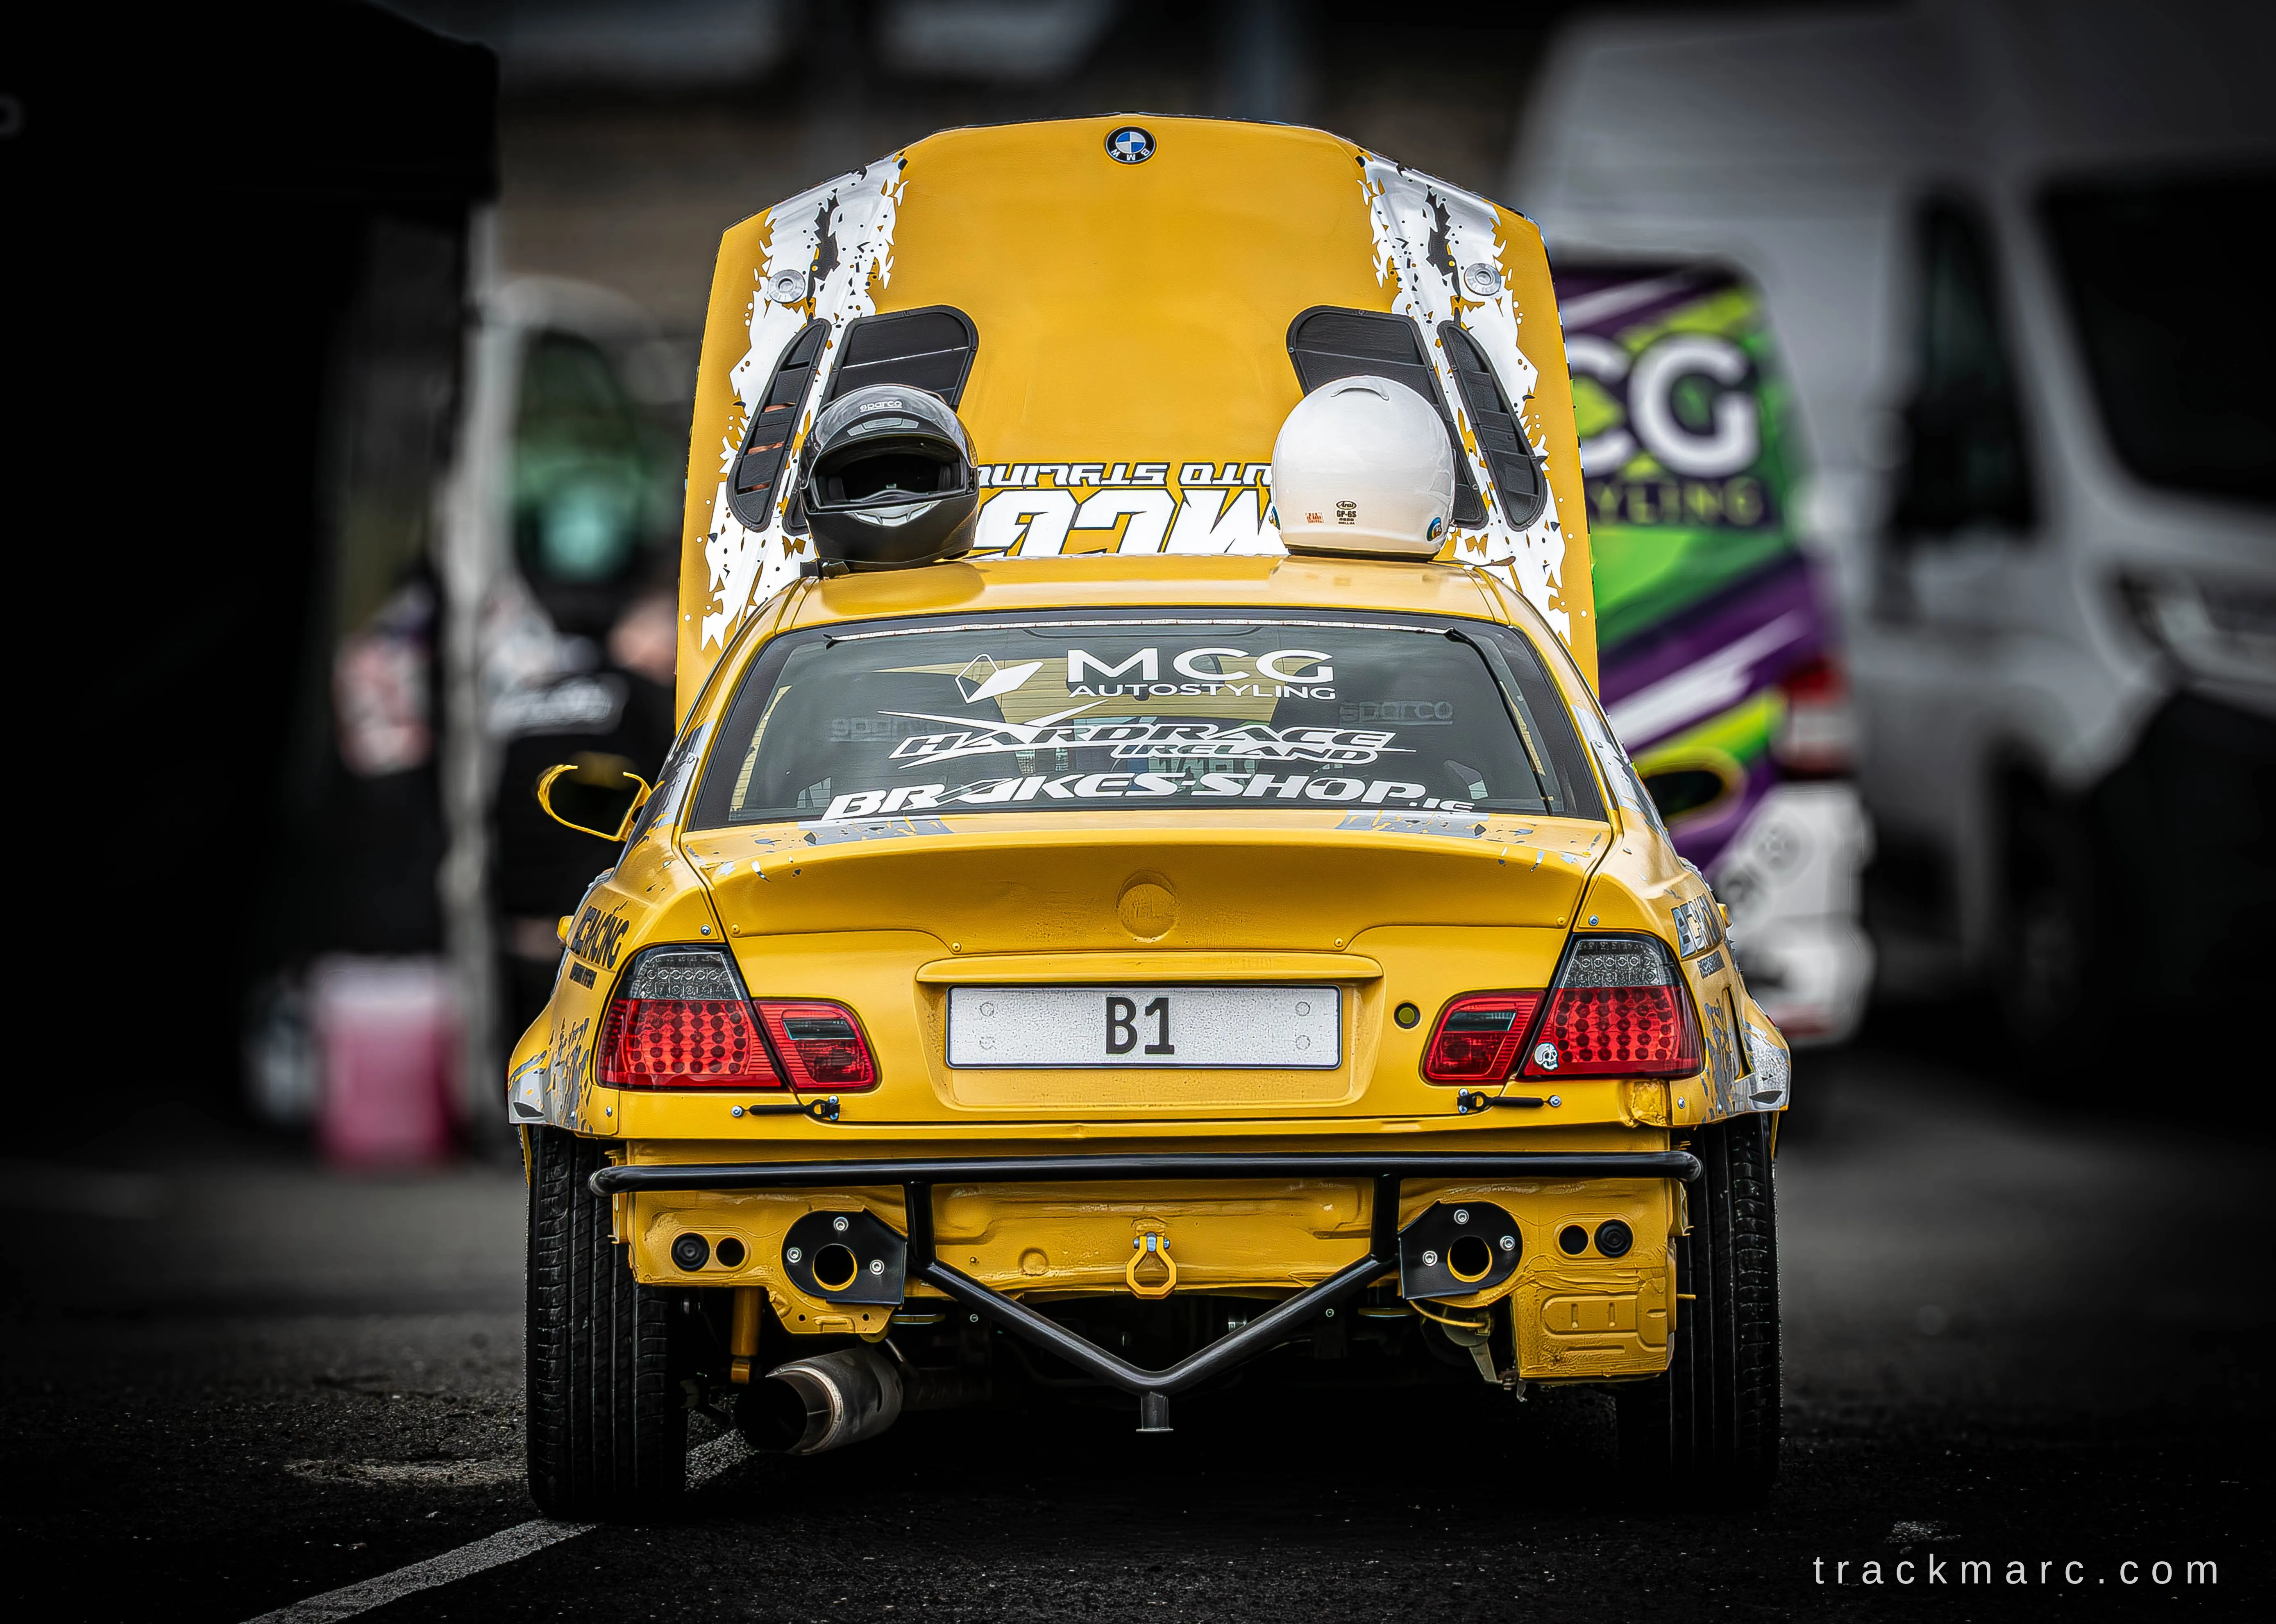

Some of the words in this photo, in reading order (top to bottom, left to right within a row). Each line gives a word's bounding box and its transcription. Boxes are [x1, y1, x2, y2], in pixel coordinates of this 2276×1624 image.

[1111, 148, 1150, 161] BMW
[860, 400, 903, 412] sparco
[1563, 333, 1761, 479] CG
[1178, 463, 1272, 488] UTO
[1586, 479, 1765, 526] YLING
[1067, 647, 1334, 684] MCG
[1068, 684, 1336, 700] AUTOSTYLING
[887, 714, 1398, 761] HARDRACE
[1110, 743, 1379, 765] IRELAND
[1105, 996, 1175, 1055] B1
